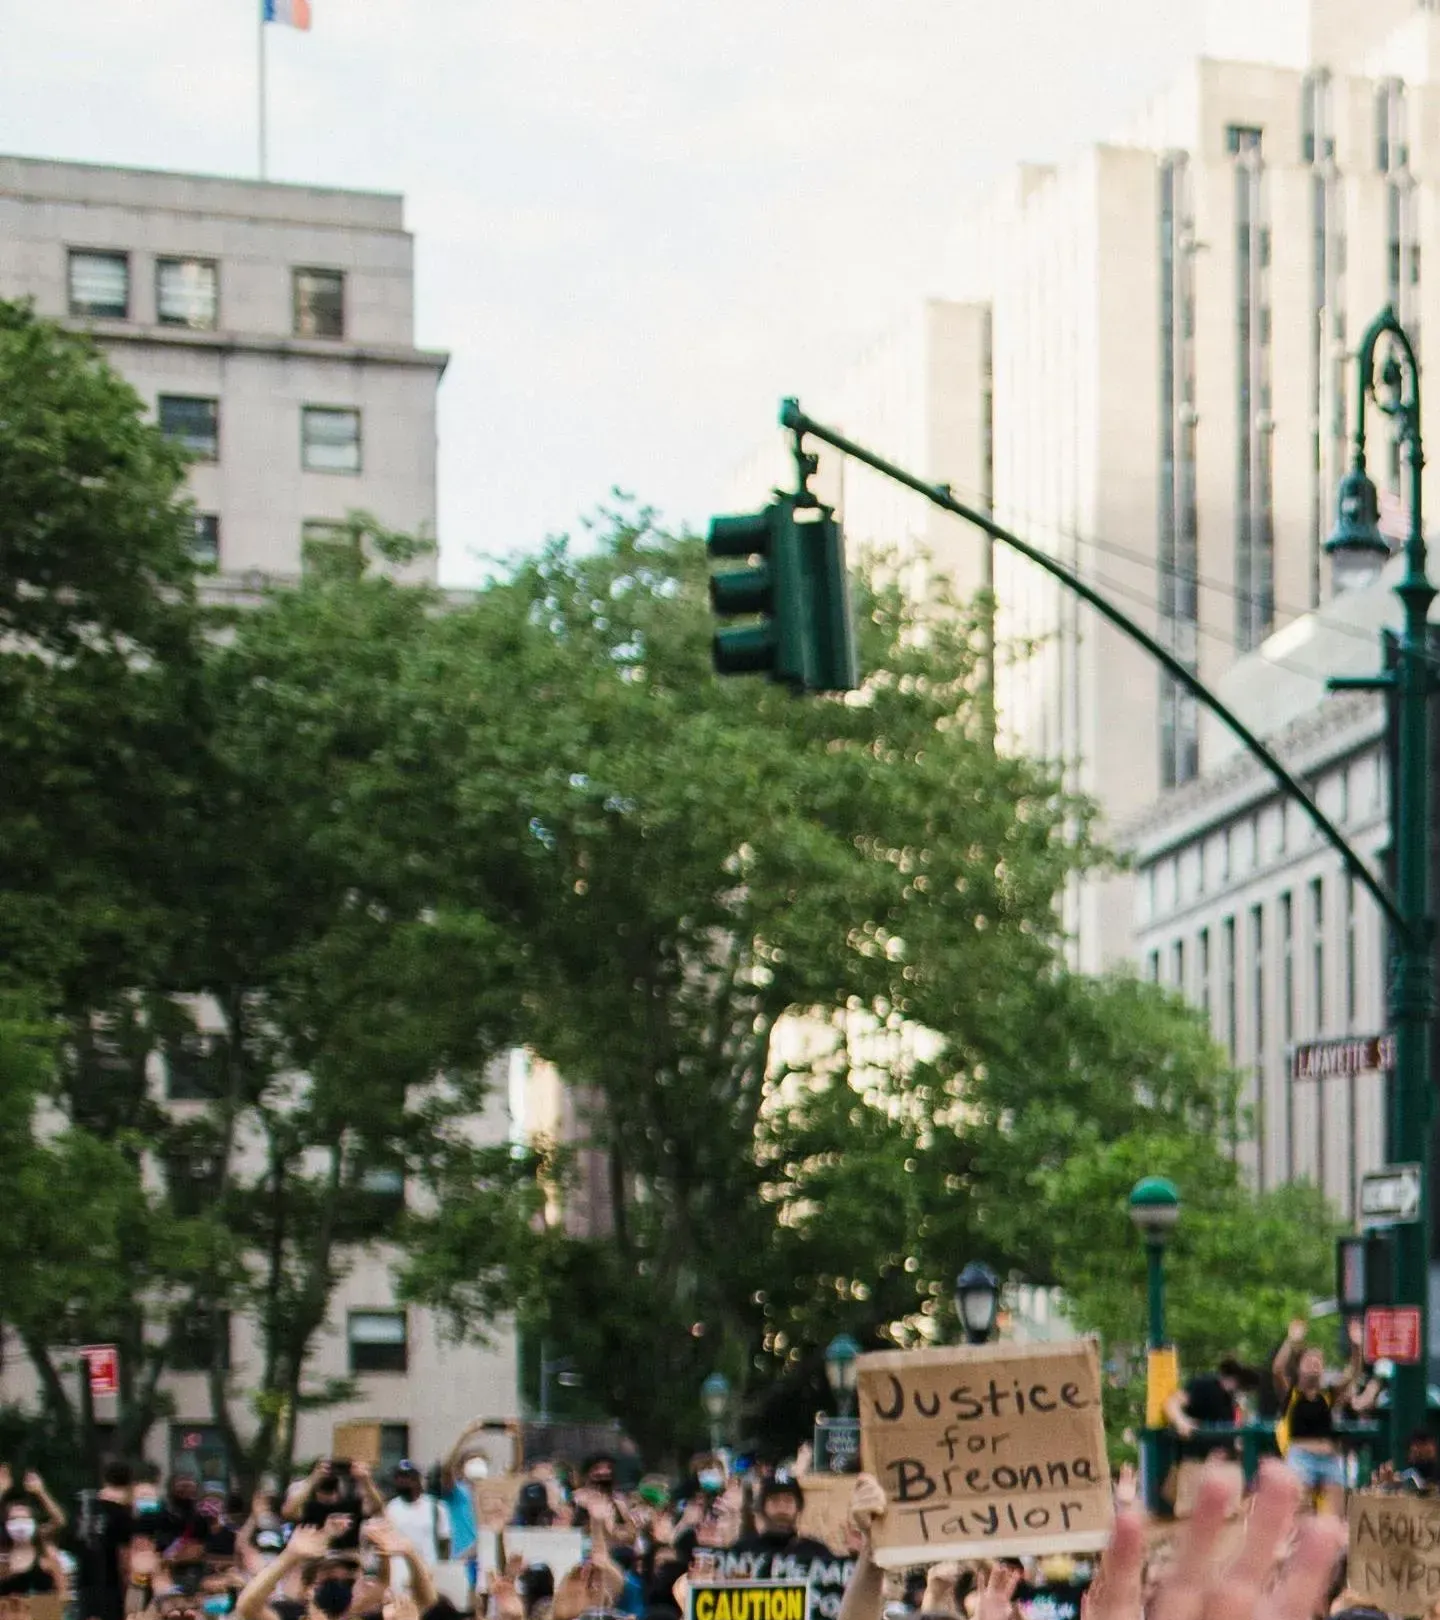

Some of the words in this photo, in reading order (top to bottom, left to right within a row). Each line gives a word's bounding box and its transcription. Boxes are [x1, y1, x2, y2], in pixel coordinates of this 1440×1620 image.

[874, 1373, 1090, 1421] Justice
[937, 1425, 1011, 1460] for
[887, 1457, 1099, 1502] Breonna
[900, 1501, 1083, 1541] Taylor
